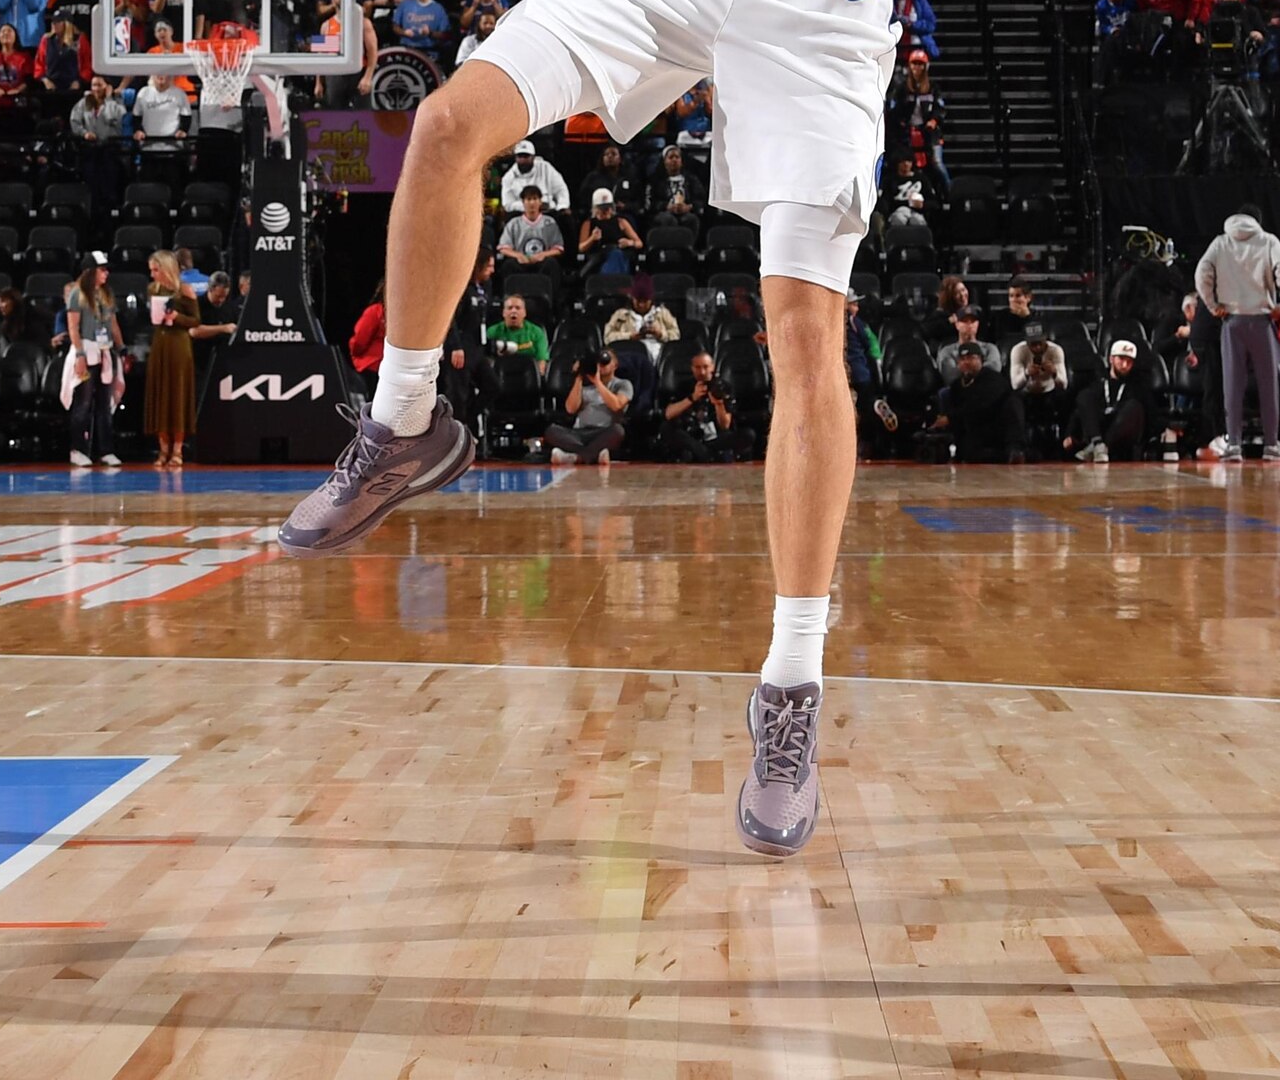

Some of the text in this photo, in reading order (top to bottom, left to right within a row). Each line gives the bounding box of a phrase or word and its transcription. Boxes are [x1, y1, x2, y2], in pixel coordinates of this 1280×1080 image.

[255, 236, 296, 251] AT&T
[245, 329, 305, 343] teradata.
[219, 374, 325, 401] KIA
